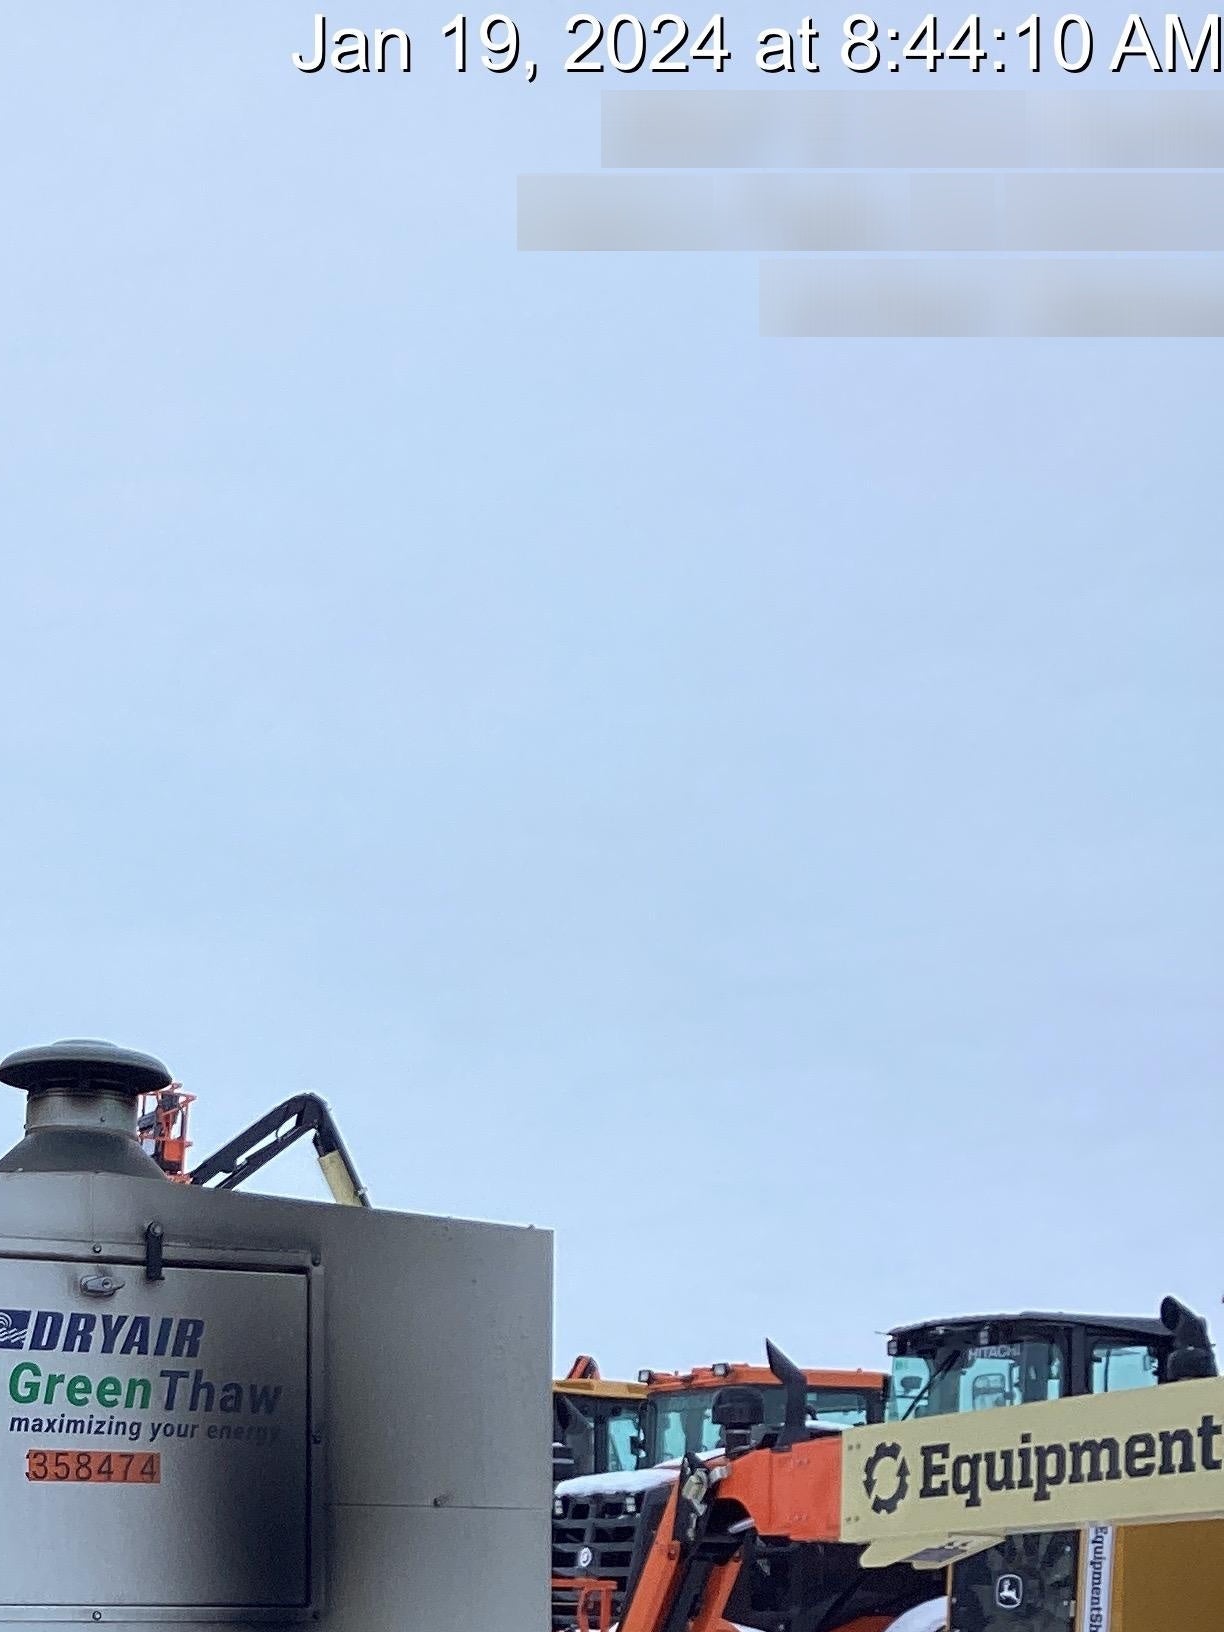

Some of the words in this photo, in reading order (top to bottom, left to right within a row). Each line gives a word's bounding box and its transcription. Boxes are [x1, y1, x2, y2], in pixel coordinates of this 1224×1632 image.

[28, 1310, 205, 1359] DRYAIR
[968, 1344, 1021, 1360] HITACHI
[8, 1413, 142, 1442] maximizing
[149, 1422, 200, 1443] your
[30, 1451, 158, 1481] 358474
[919, 1414, 1223, 1508] Equipment
